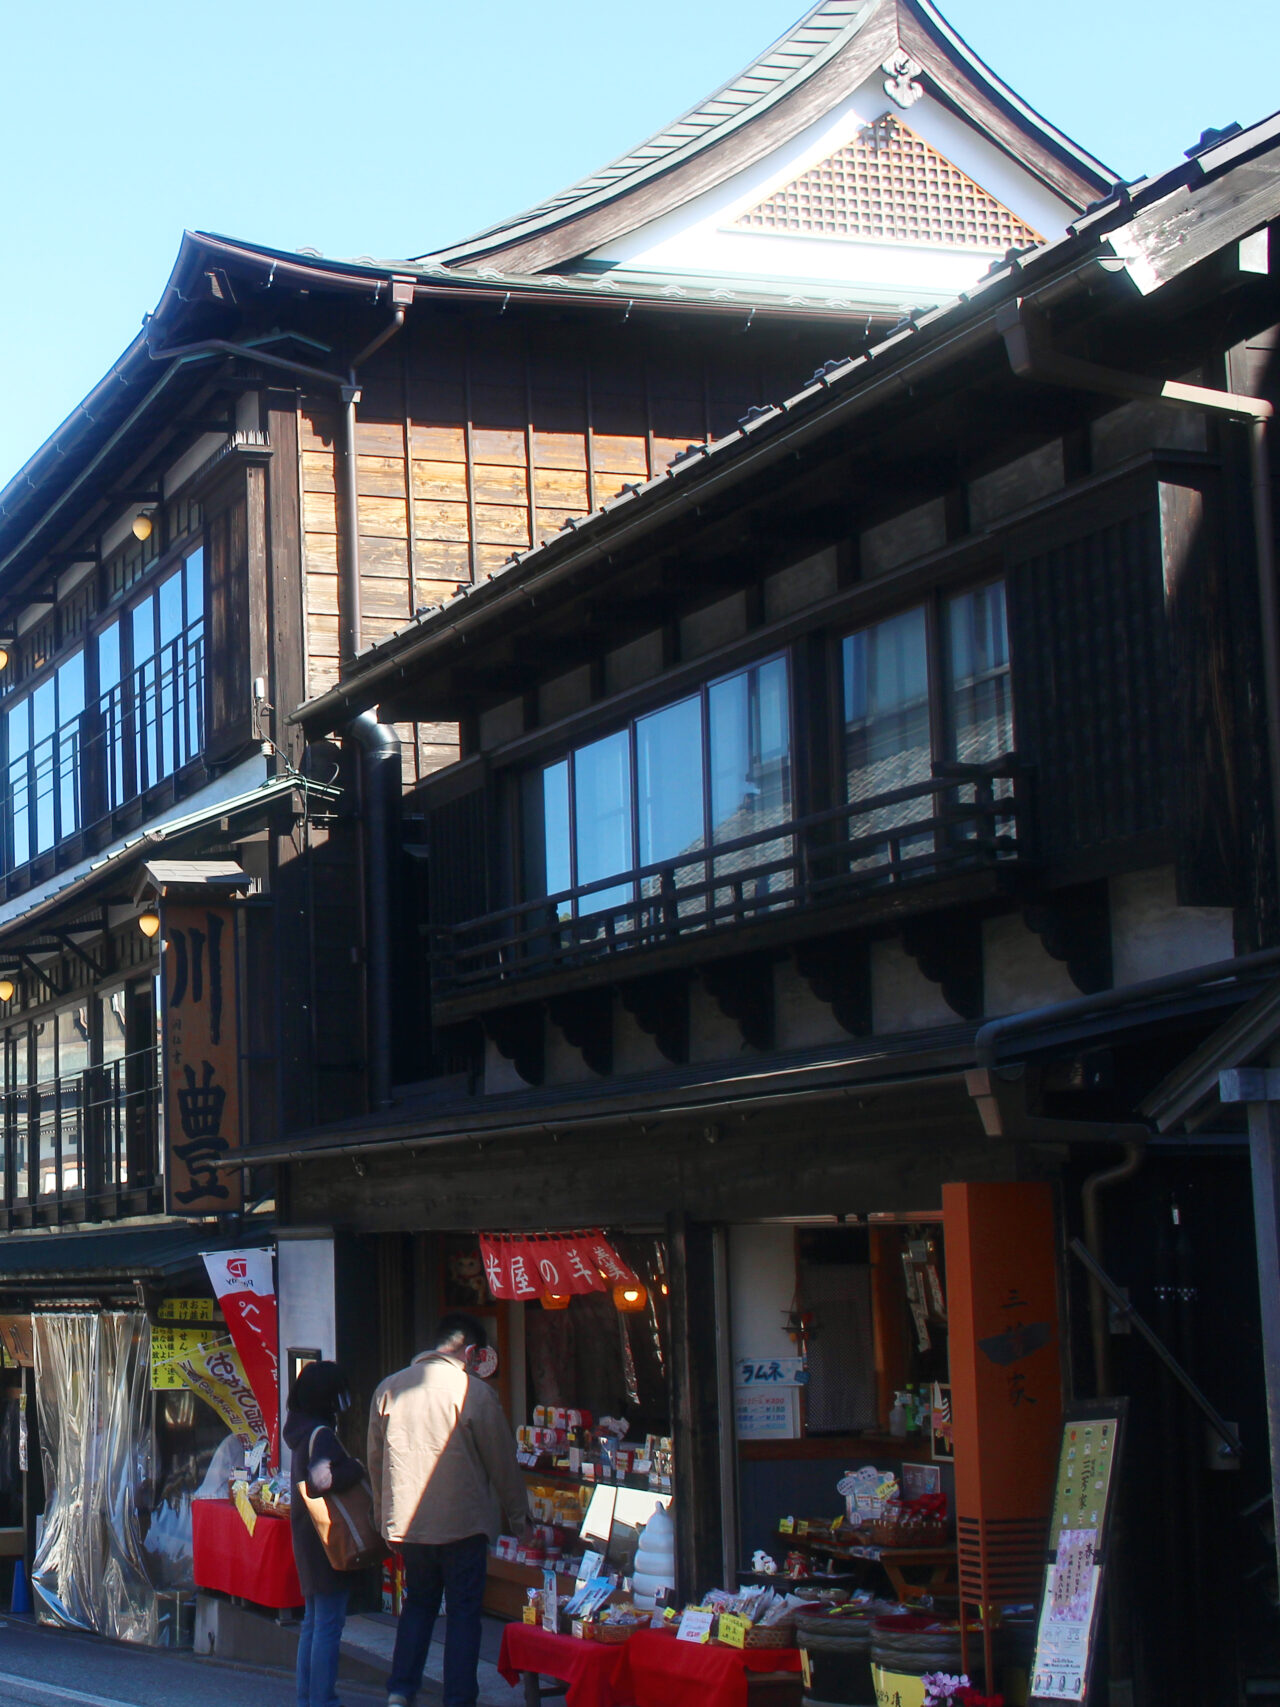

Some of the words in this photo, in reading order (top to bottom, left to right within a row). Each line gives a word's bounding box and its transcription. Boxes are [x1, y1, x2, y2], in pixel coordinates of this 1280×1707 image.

[168, 912, 232, 1205] 川豊
[741, 1361, 786, 1383] ラムネ
